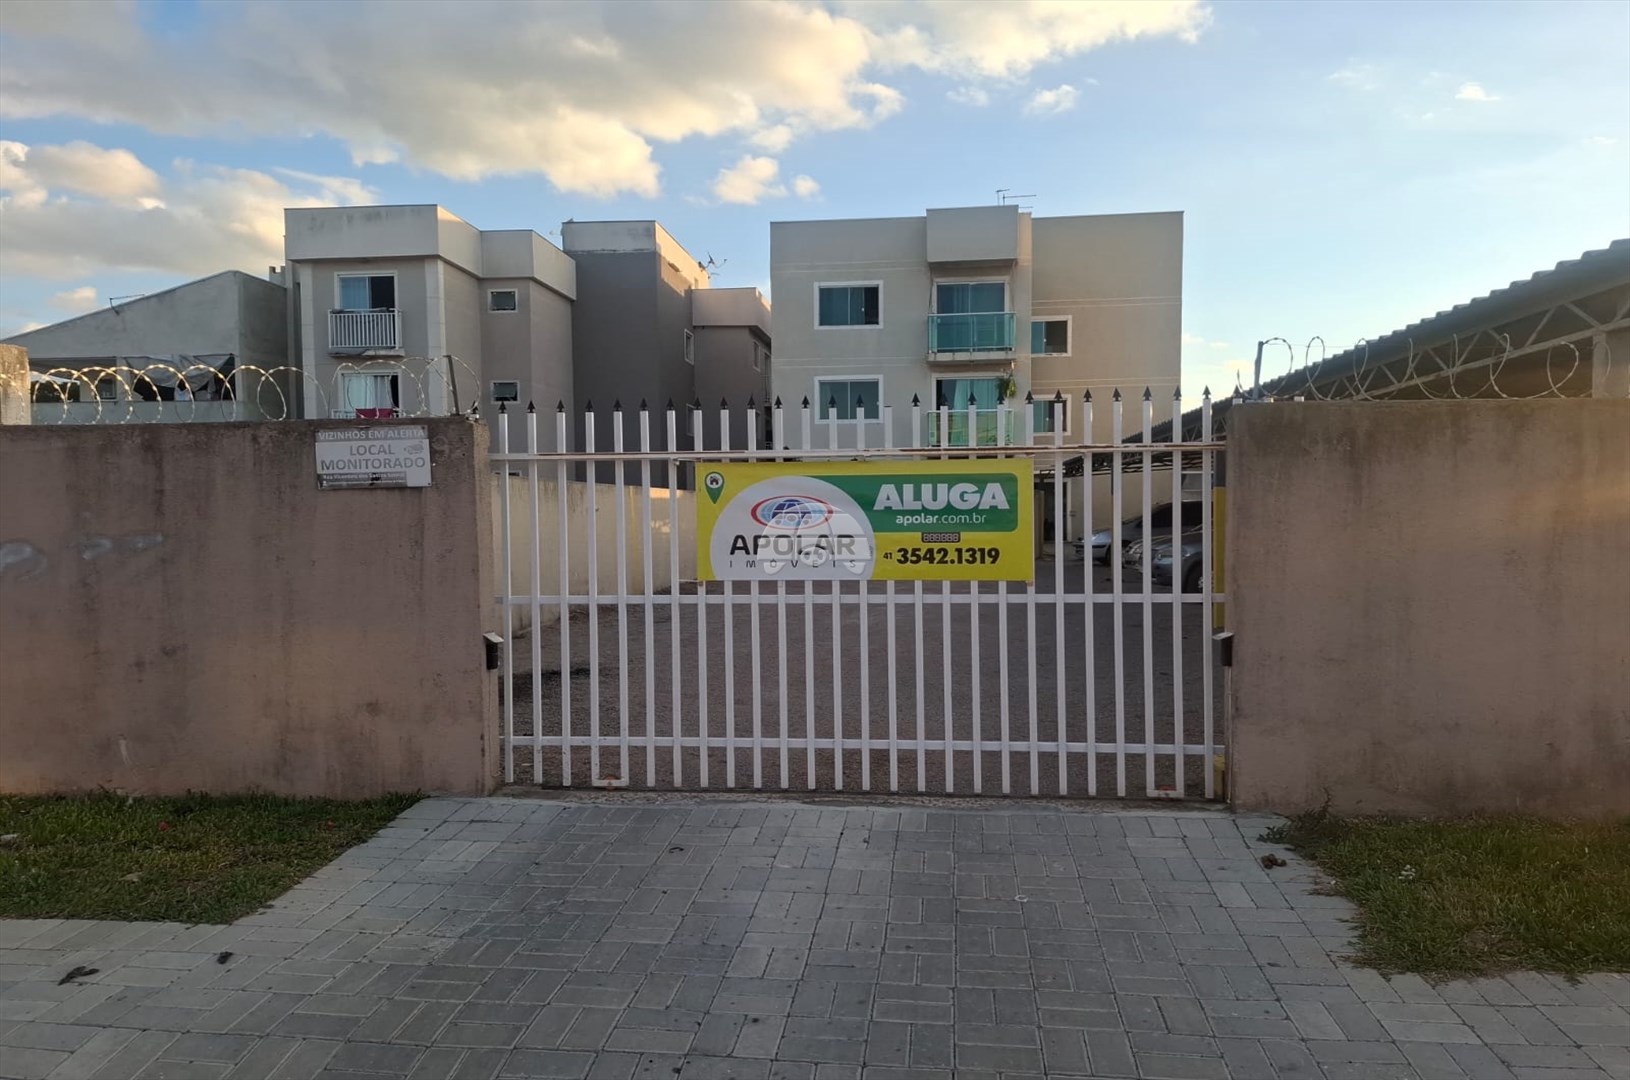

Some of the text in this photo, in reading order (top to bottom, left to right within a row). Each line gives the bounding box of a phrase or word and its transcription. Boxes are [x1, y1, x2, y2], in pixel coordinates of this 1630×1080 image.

[318, 429, 425, 440] VIZINHOS EM ALERTA
[349, 443, 396, 456] LOCAL
[320, 457, 426, 471] MONITORADO
[873, 482, 1010, 510] ALUGA
[895, 512, 987, 526] apolar.com.br
[729, 534, 856, 556] APOLAR
[883, 547, 1000, 565] 41 3542.1319
